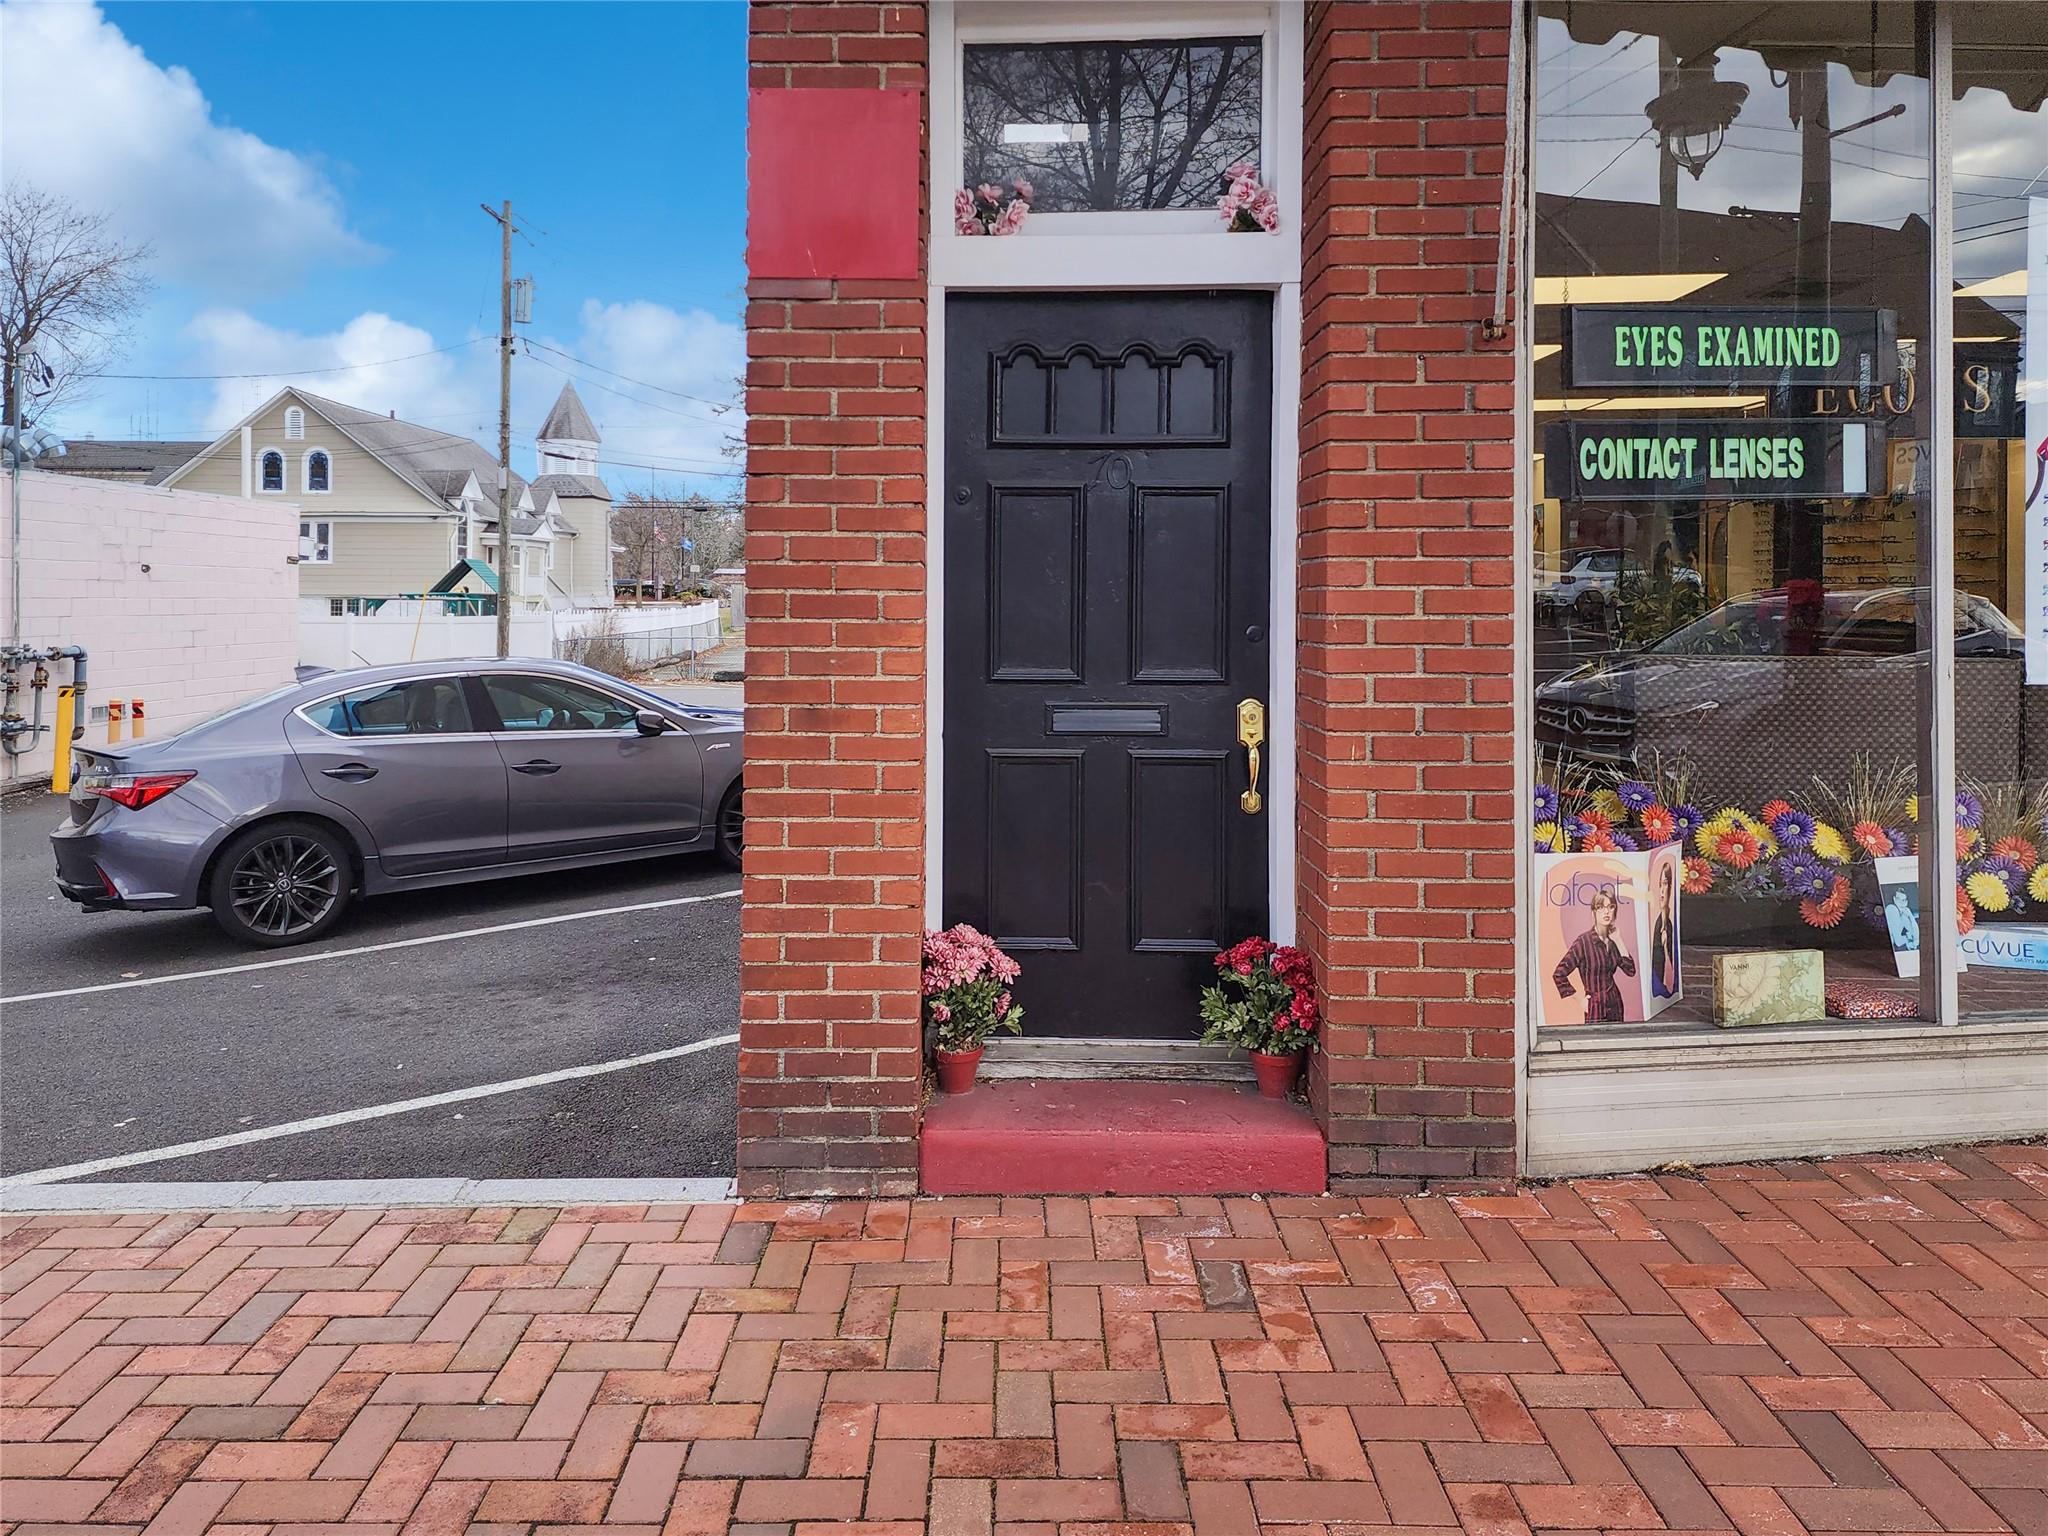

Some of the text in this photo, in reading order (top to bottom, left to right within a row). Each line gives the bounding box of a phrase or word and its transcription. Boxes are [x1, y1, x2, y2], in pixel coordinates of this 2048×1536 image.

[1615, 326, 1840, 367] EYES EXAMINED
[1580, 437, 1804, 480] CONTACT LENSES
[1957, 938, 2035, 959] CUVUE
[1729, 962, 1750, 971] VANNI
